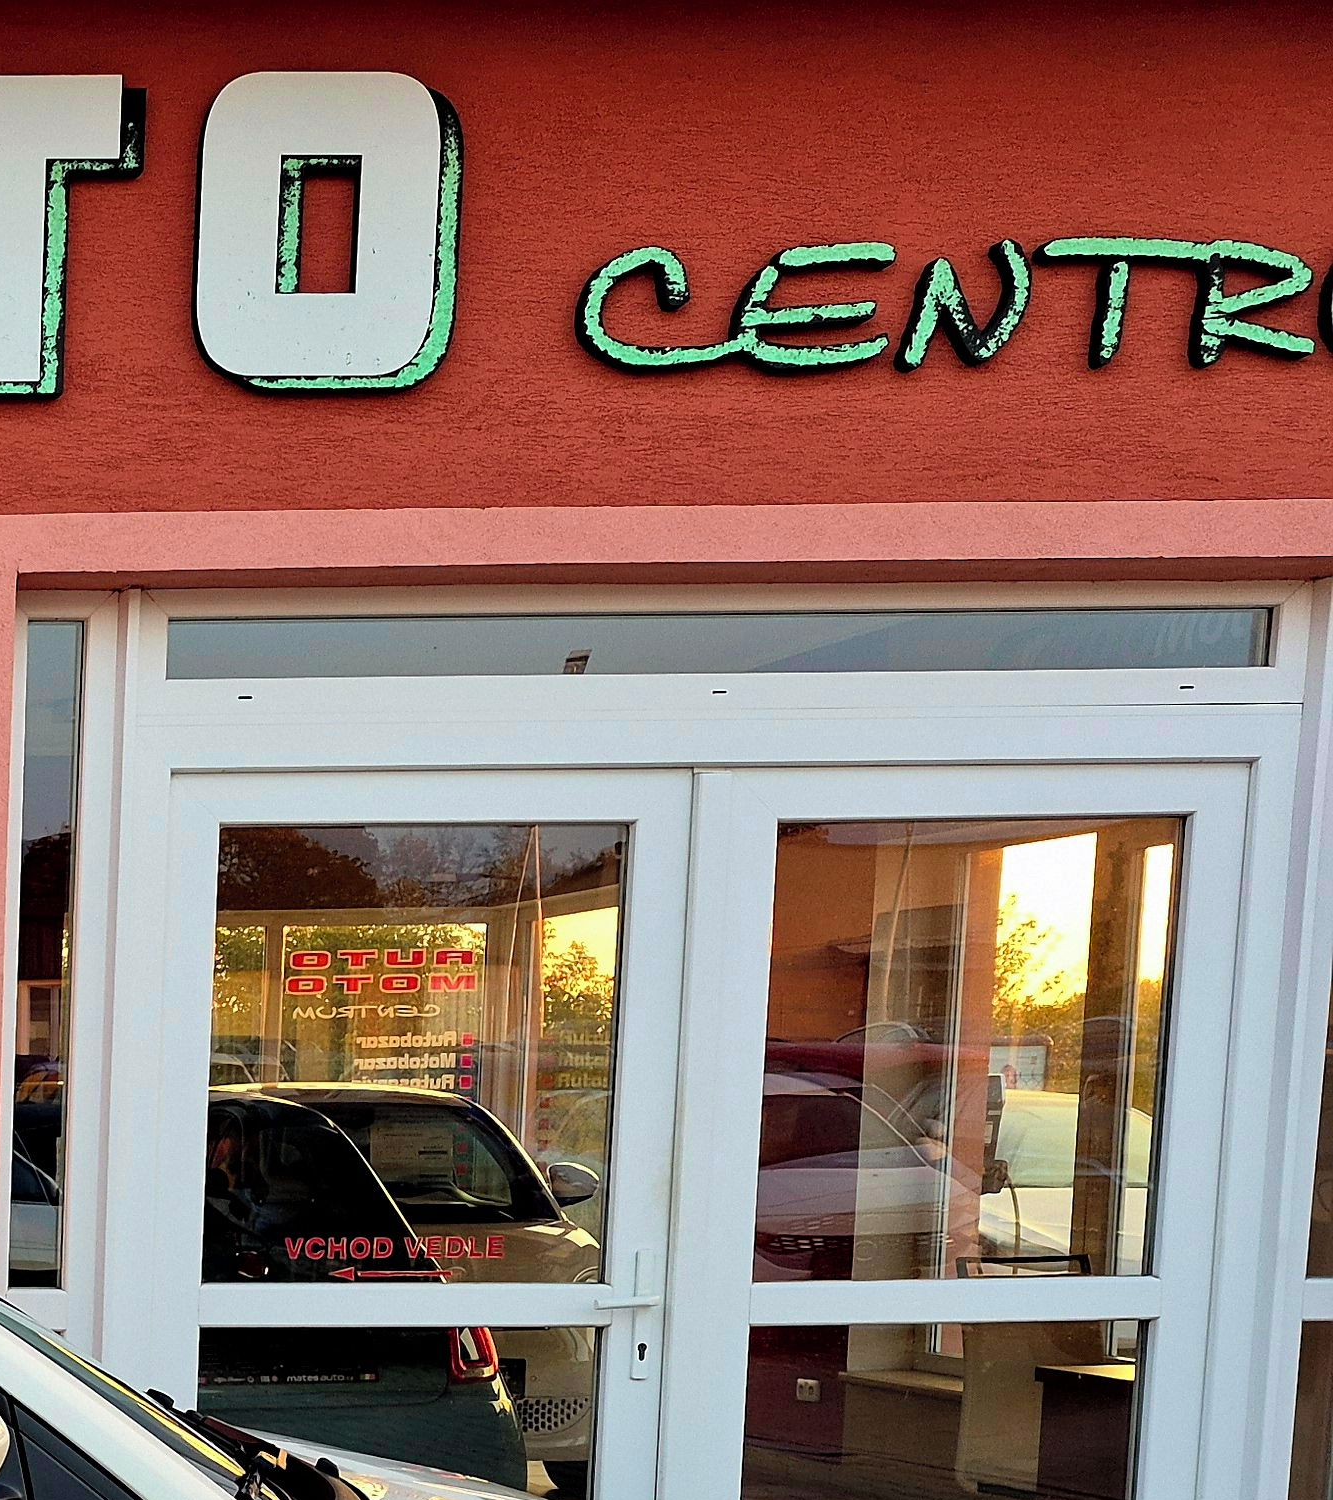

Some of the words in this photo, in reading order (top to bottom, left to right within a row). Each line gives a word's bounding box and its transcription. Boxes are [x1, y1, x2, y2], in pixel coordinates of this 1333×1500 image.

[575, 237, 1333, 373] CENTR
[284, 1236, 394, 1260] VCHOD
[403, 1234, 506, 1260] VEDLE
